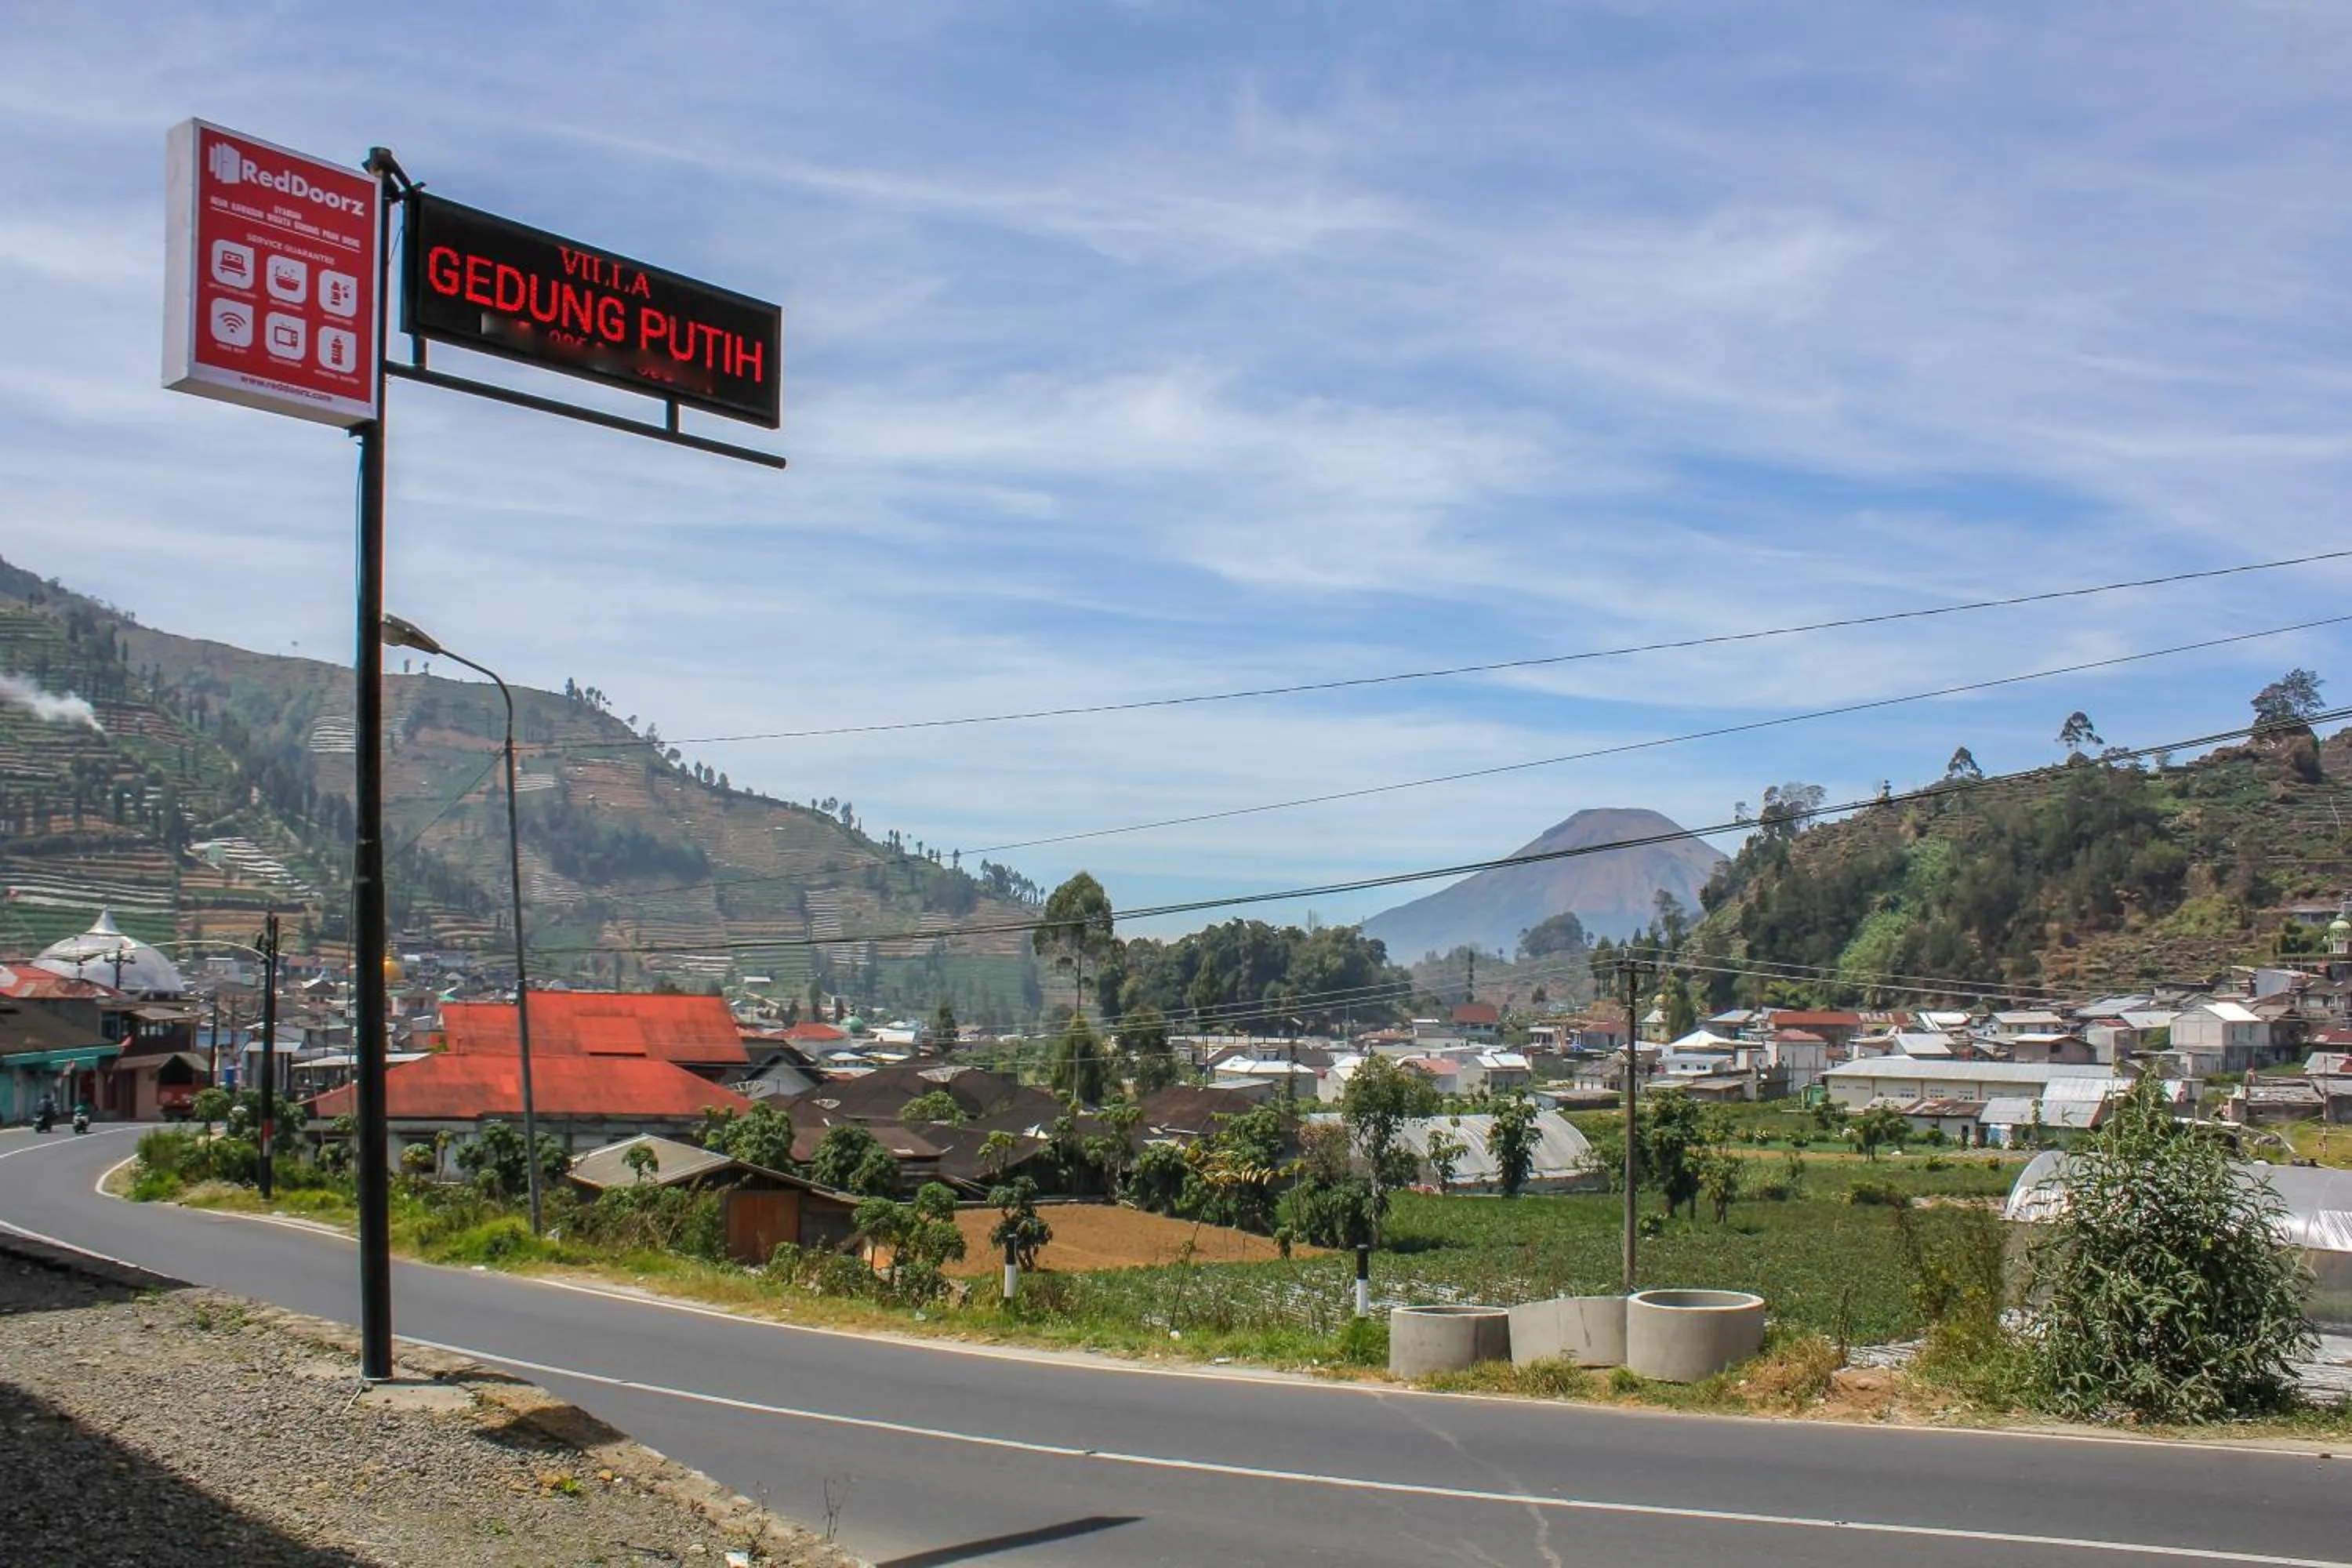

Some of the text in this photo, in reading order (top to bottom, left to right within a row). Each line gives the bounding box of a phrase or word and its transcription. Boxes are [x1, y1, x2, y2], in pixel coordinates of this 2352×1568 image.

[241, 158, 365, 216] RedDoorz
[246, 233, 284, 250] SERVICE
[427, 245, 763, 383] GEDUNG PUTIH
